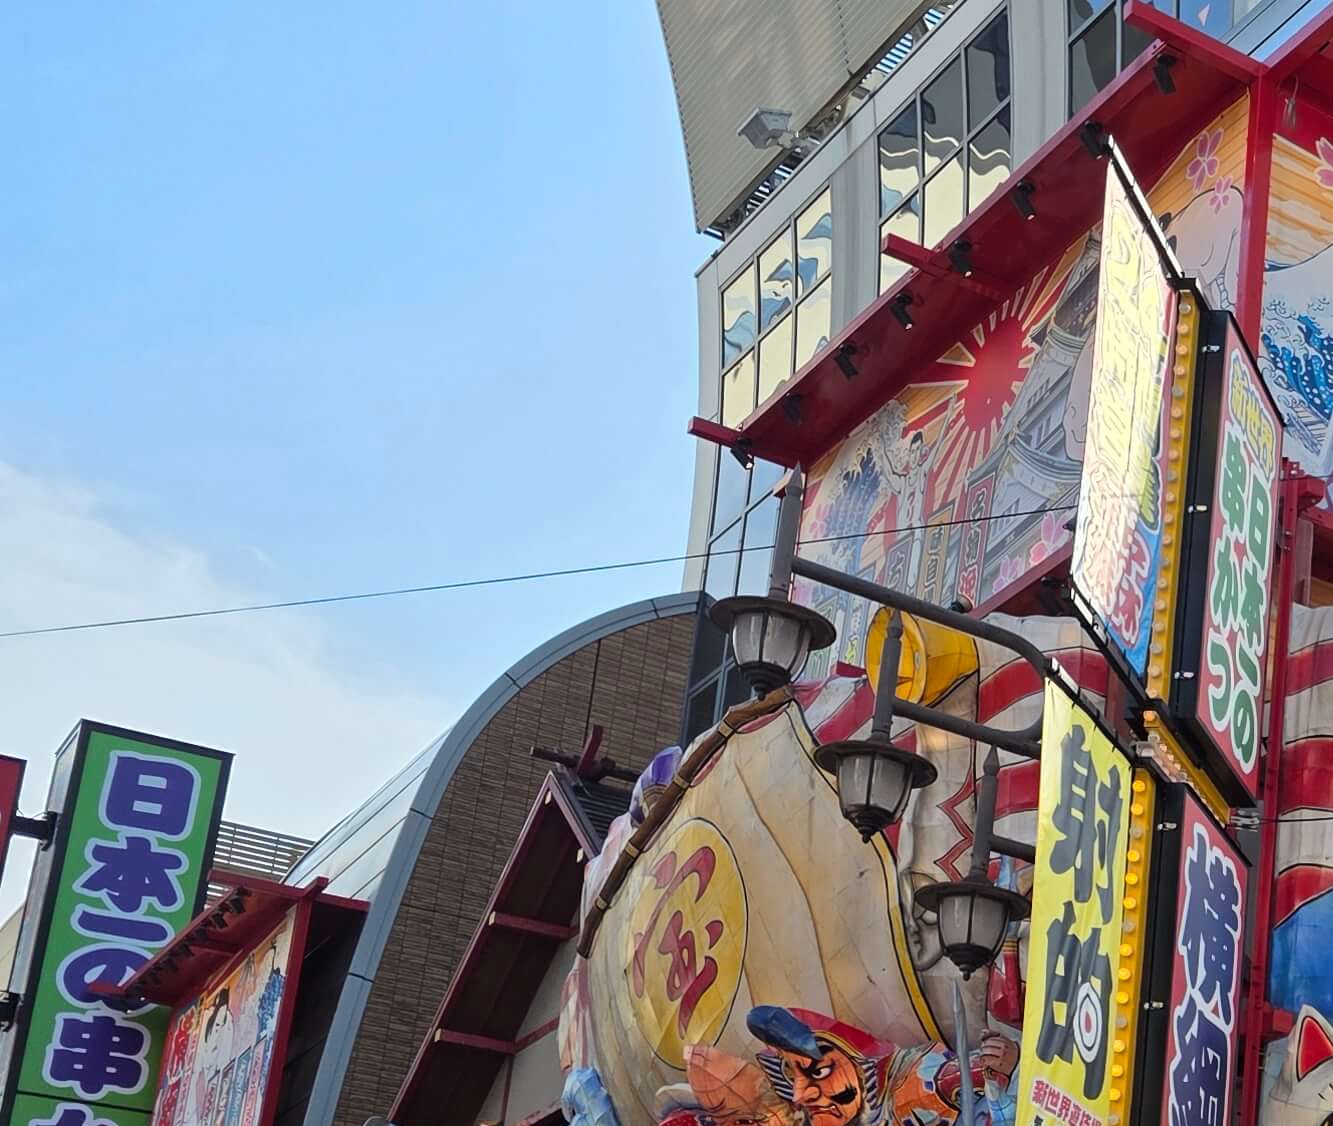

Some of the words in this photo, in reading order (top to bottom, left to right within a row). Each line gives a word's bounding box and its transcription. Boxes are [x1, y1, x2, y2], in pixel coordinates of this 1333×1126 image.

[1229, 348, 1275, 478] 新世界
[1206, 427, 1247, 732] 串かつ
[1231, 465, 1271, 774] 日本一の
[1037, 724, 1121, 1099] 射的
